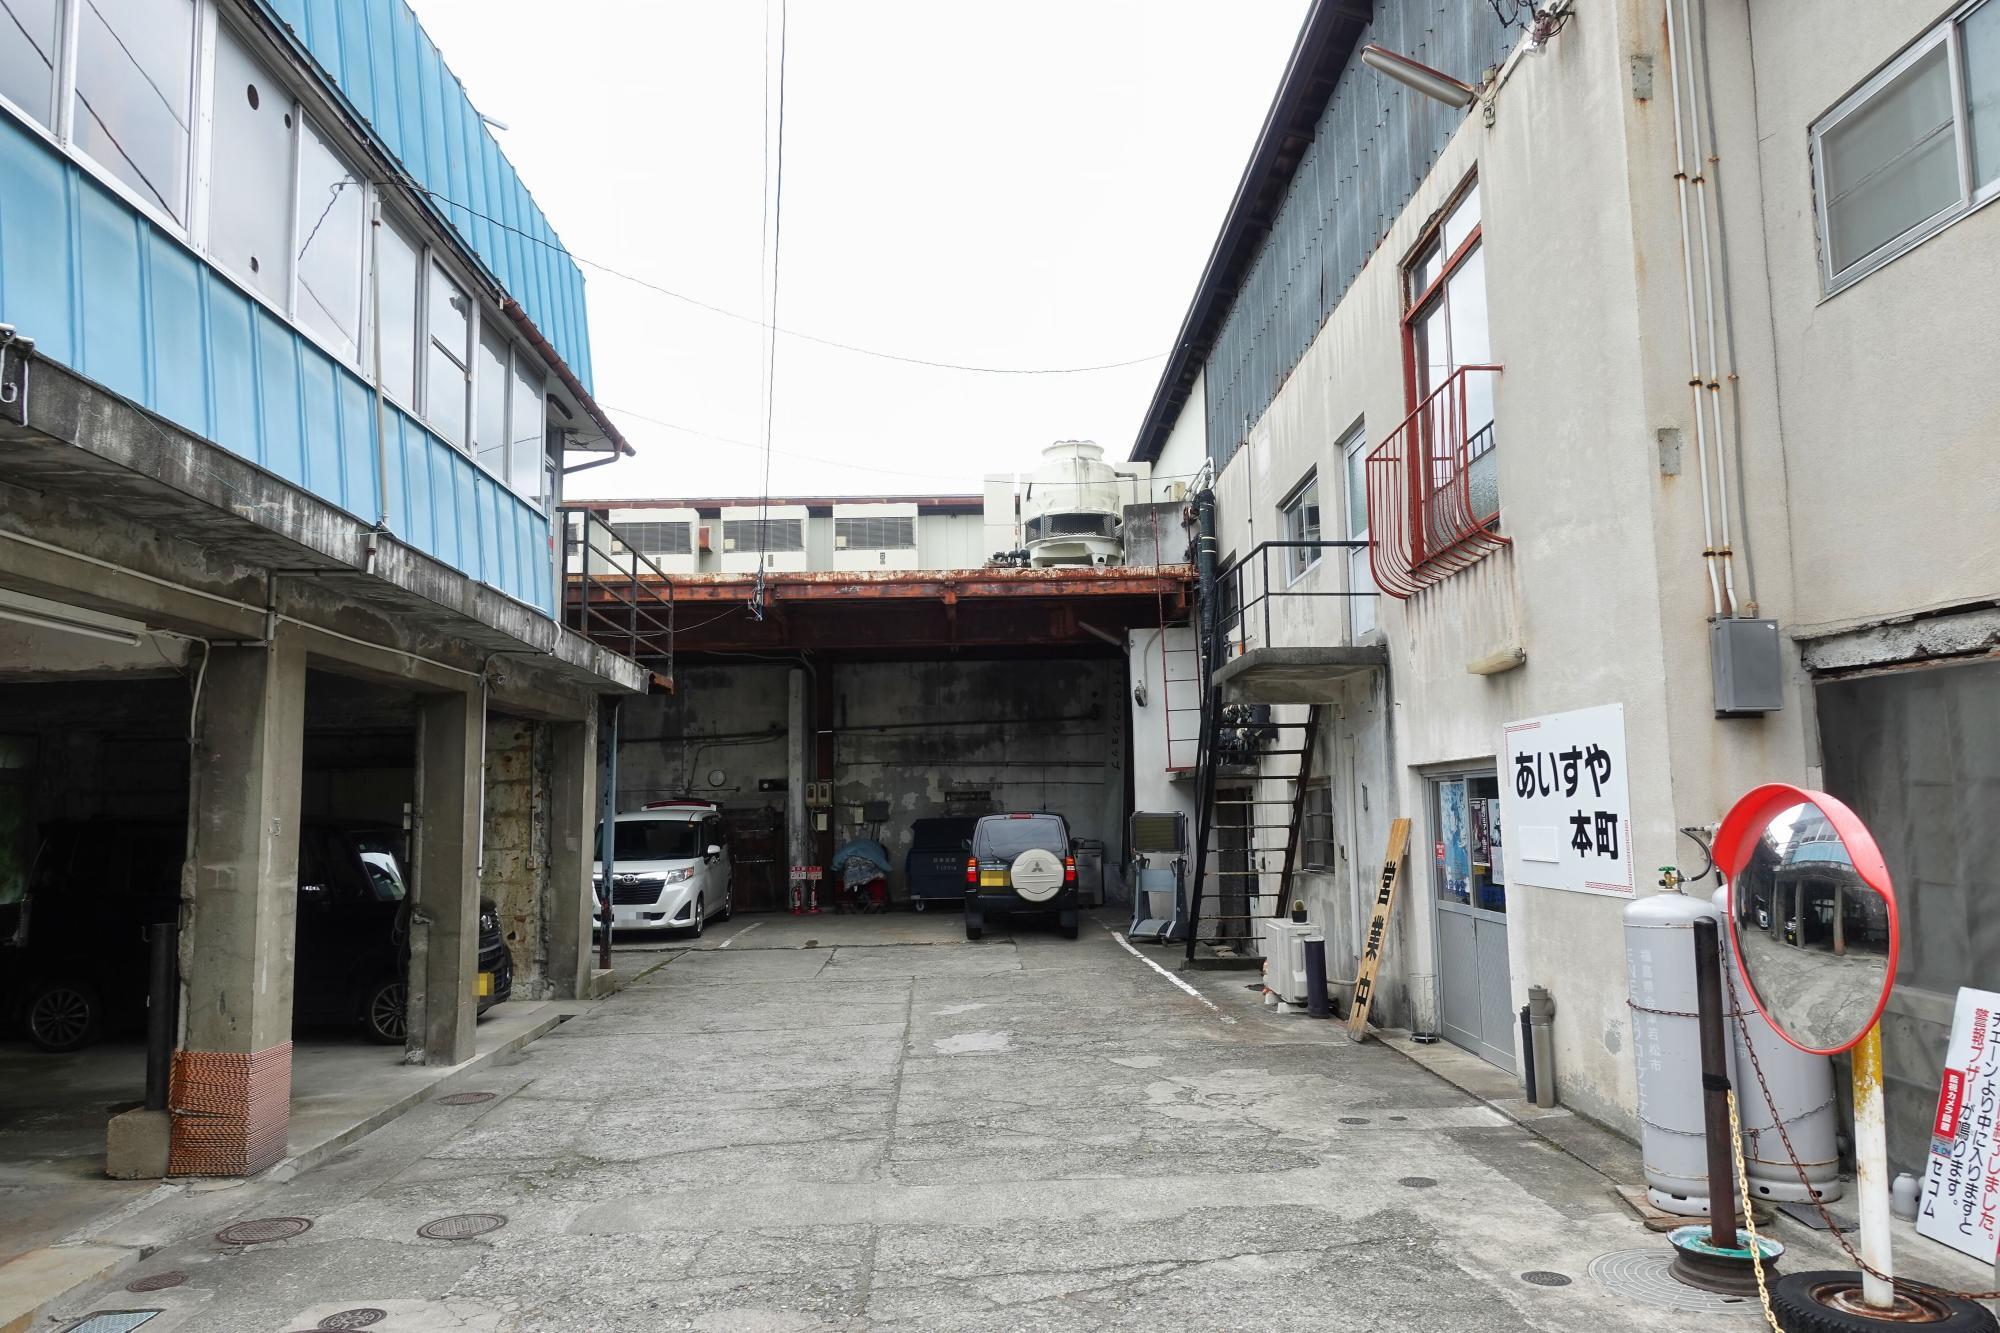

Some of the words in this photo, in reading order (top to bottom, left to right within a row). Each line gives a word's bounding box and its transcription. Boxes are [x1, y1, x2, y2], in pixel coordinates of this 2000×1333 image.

[1515, 744, 1612, 800] あいすや
[1569, 809, 1619, 860] 本町
[1355, 860, 1397, 1018] 営業中
[1923, 1158, 1943, 1219] セコム
